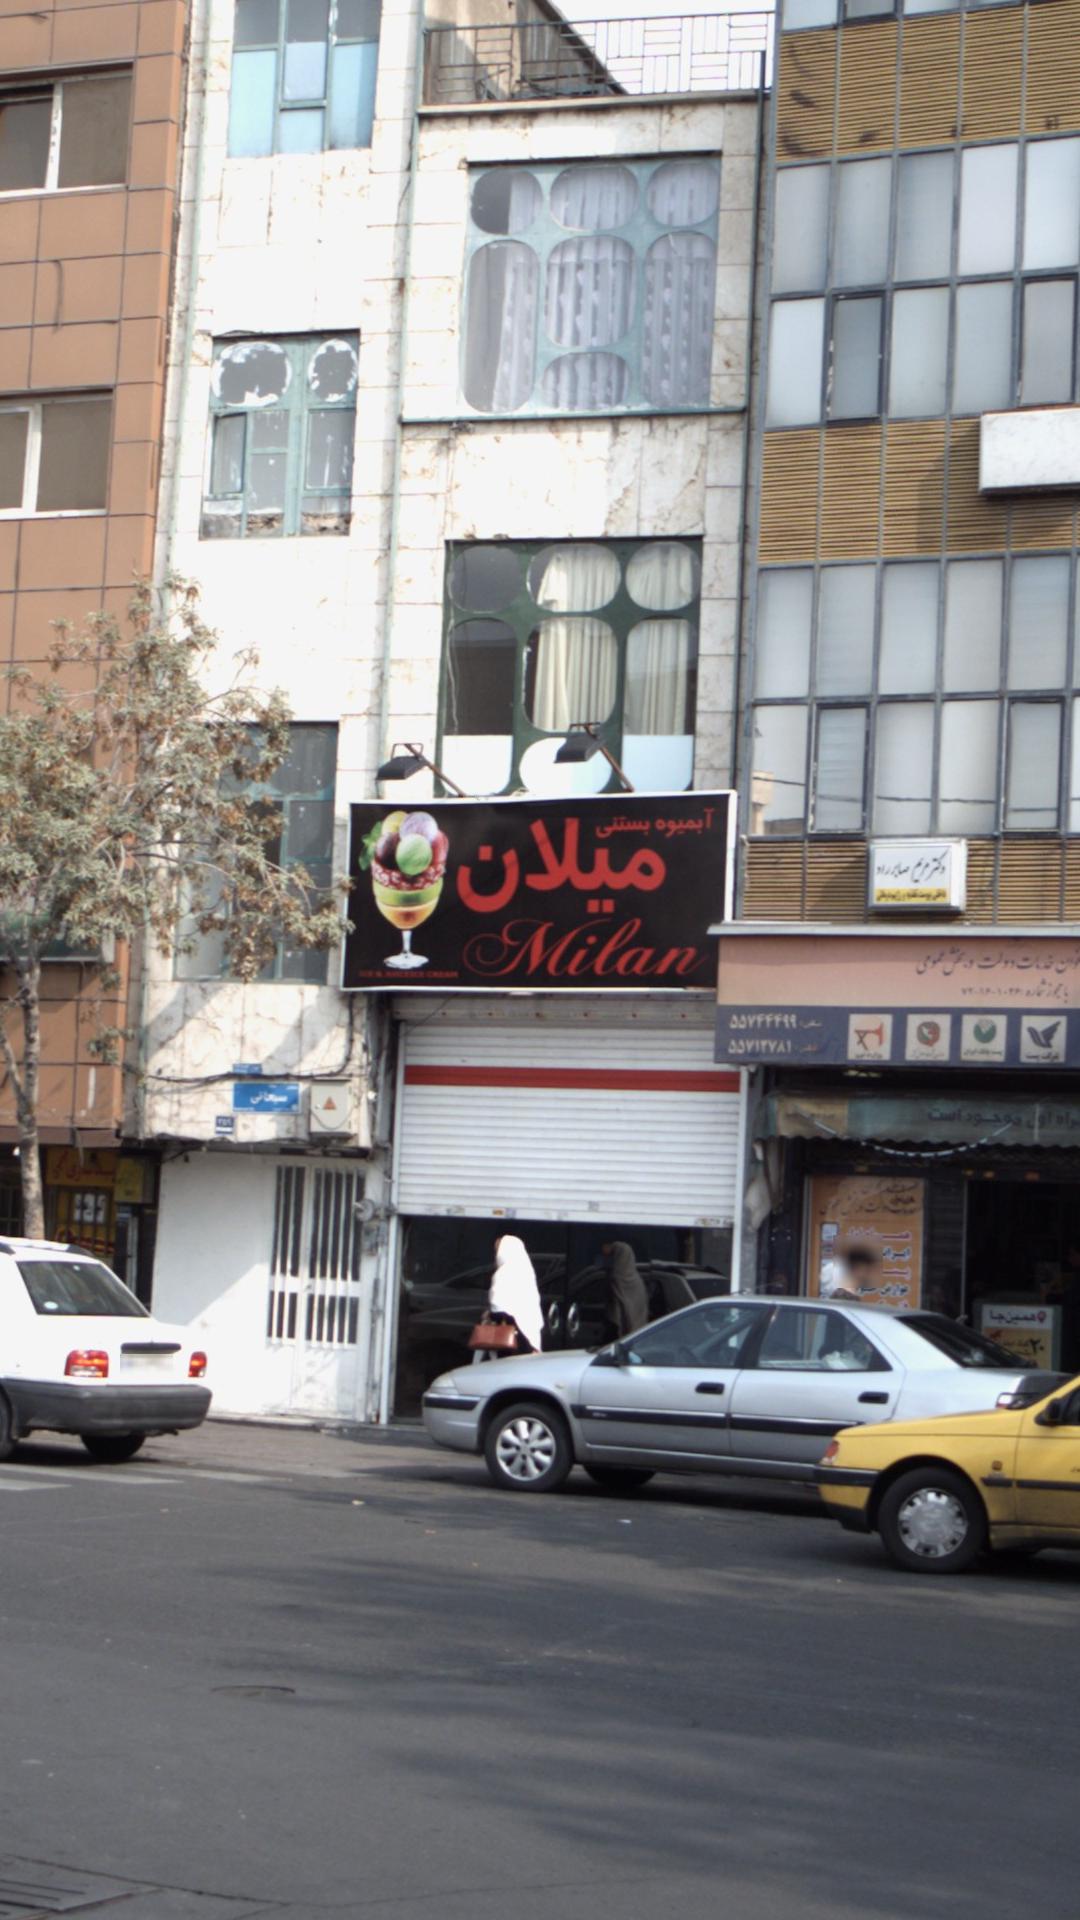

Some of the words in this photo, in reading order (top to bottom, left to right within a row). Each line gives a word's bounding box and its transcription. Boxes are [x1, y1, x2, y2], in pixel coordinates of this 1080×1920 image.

[596, 816, 651, 839] بستنی
[655, 806, 715, 838] آبمیوه
[456, 817, 667, 913] میلان
[463, 917, 706, 977] Milan
